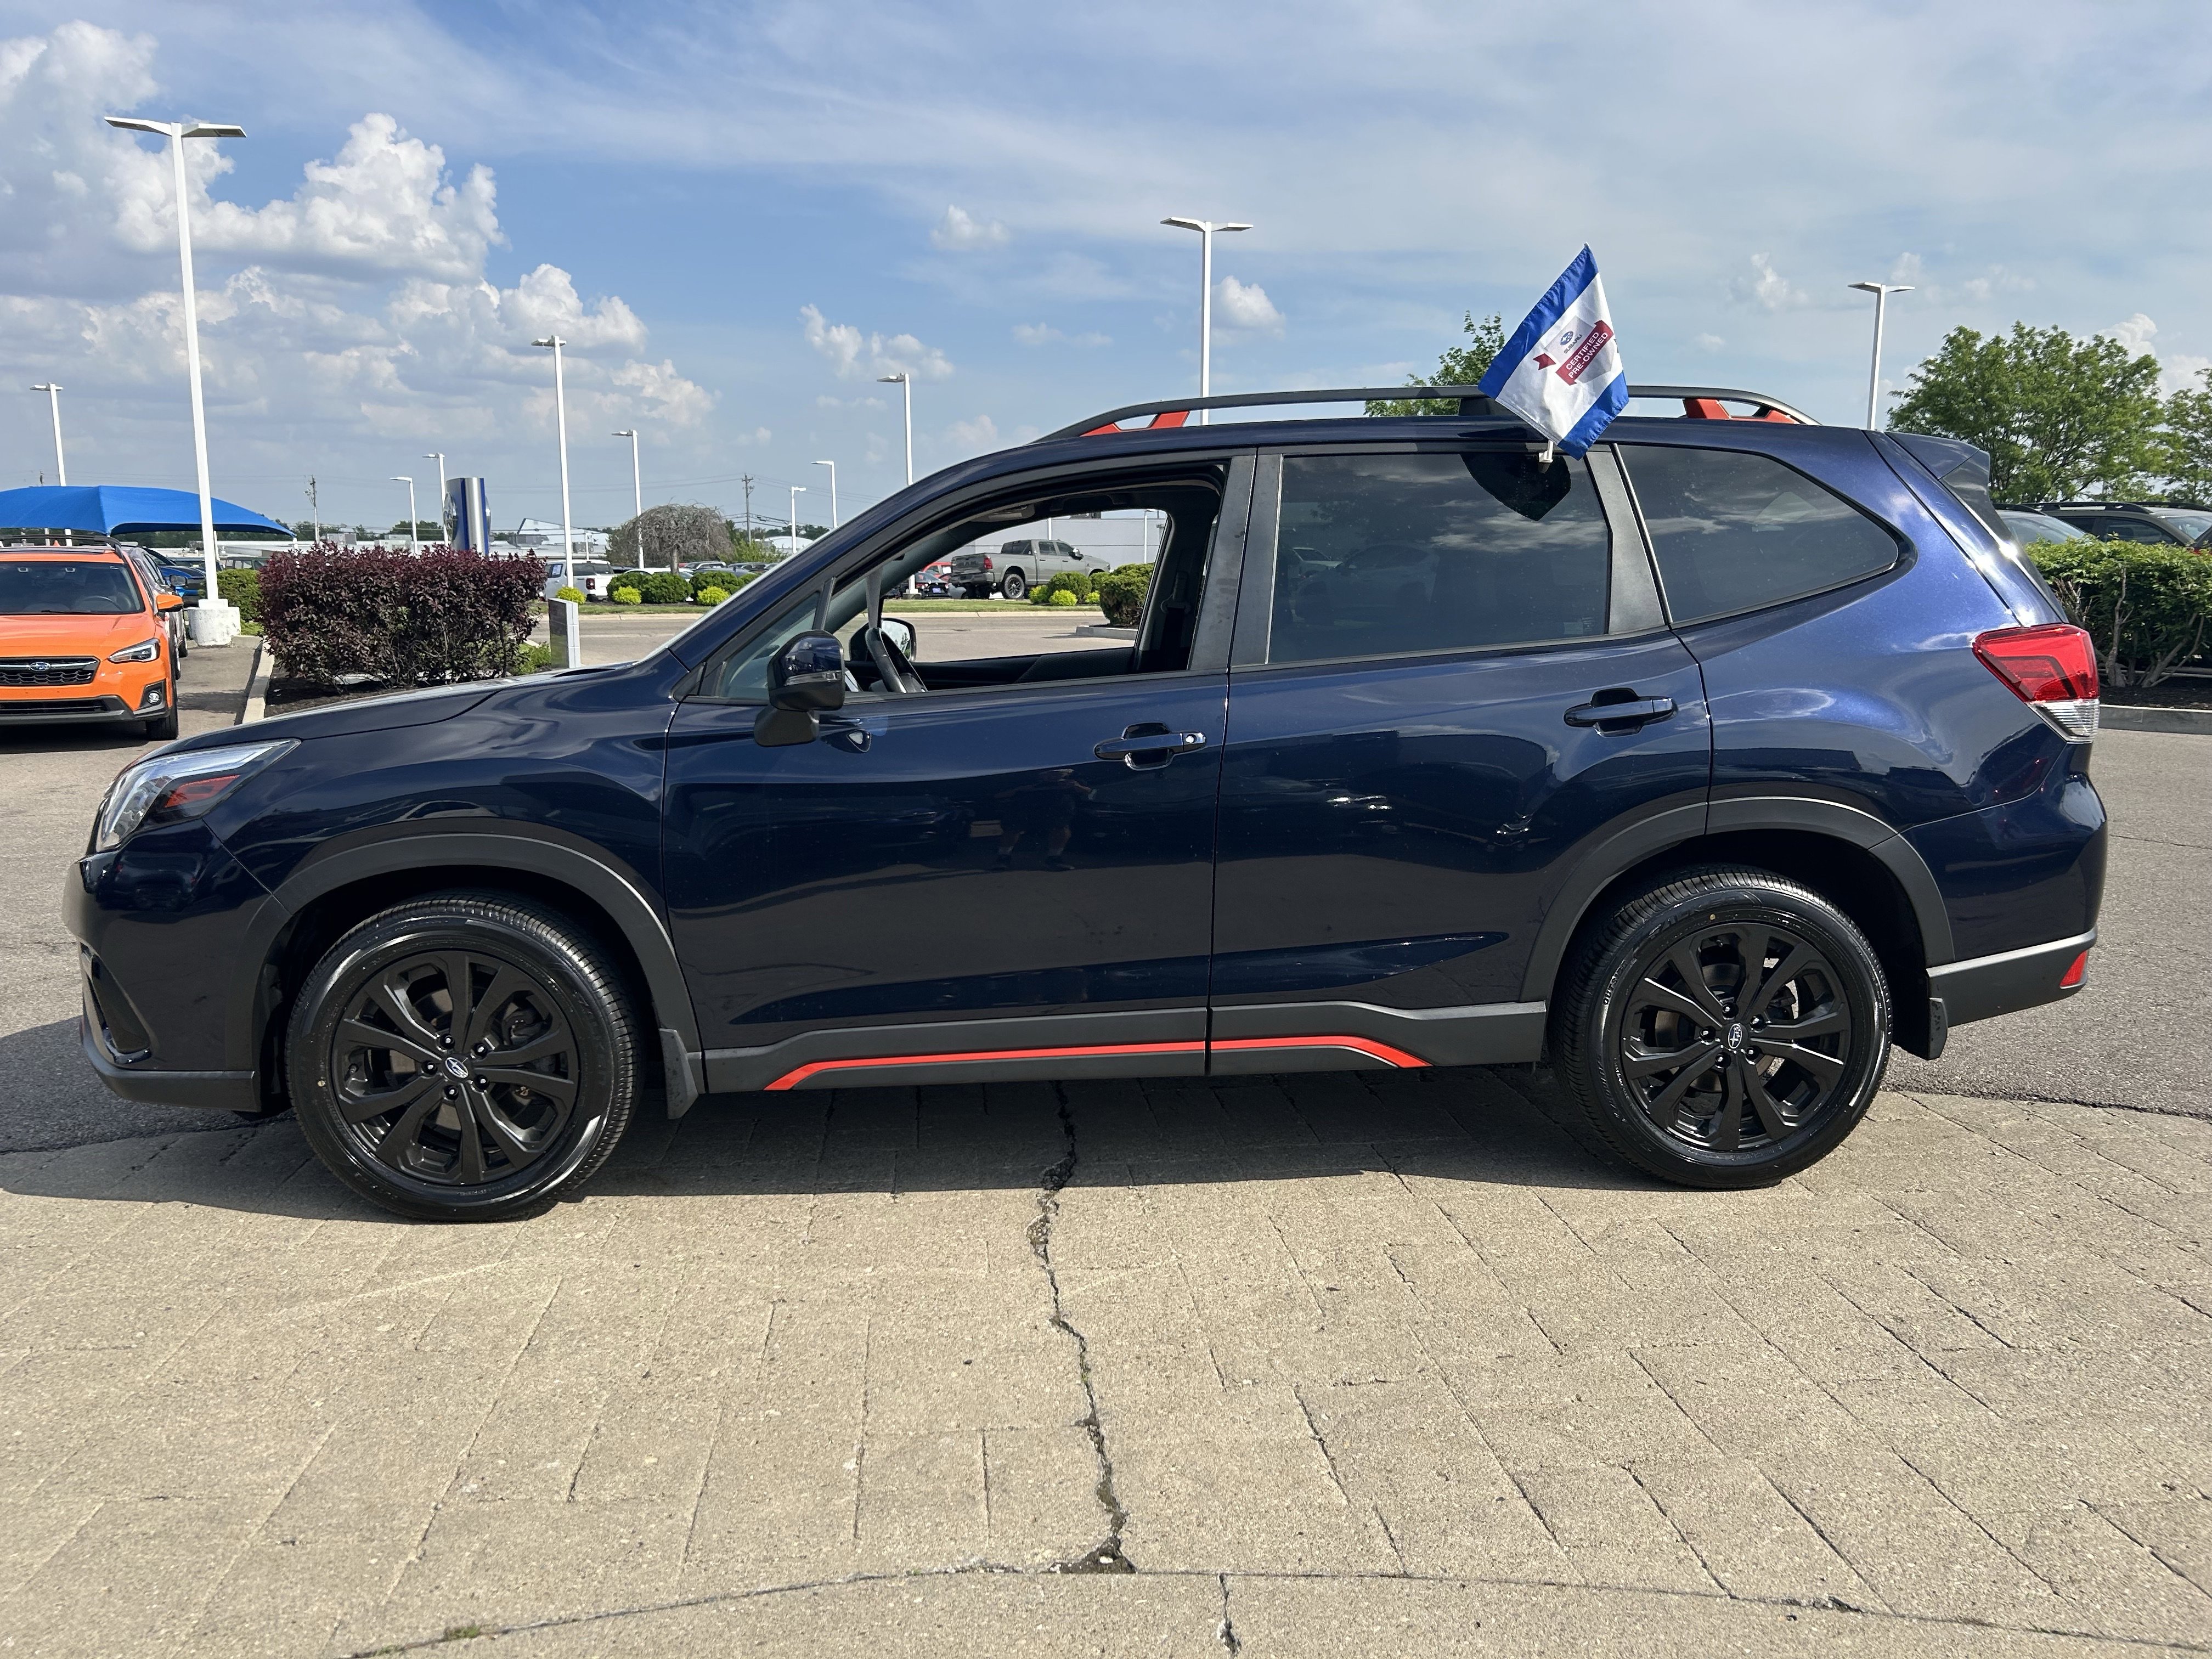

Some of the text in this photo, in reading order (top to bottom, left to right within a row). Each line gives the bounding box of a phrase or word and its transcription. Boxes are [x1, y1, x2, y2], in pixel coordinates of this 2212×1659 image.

[1564, 334, 1582, 354] SUBARU
[1566, 332, 1599, 370] CERTIFIED
[1568, 332, 1609, 379] PRE-OWNED
[1603, 960, 1628, 1005] OUTSIDE
